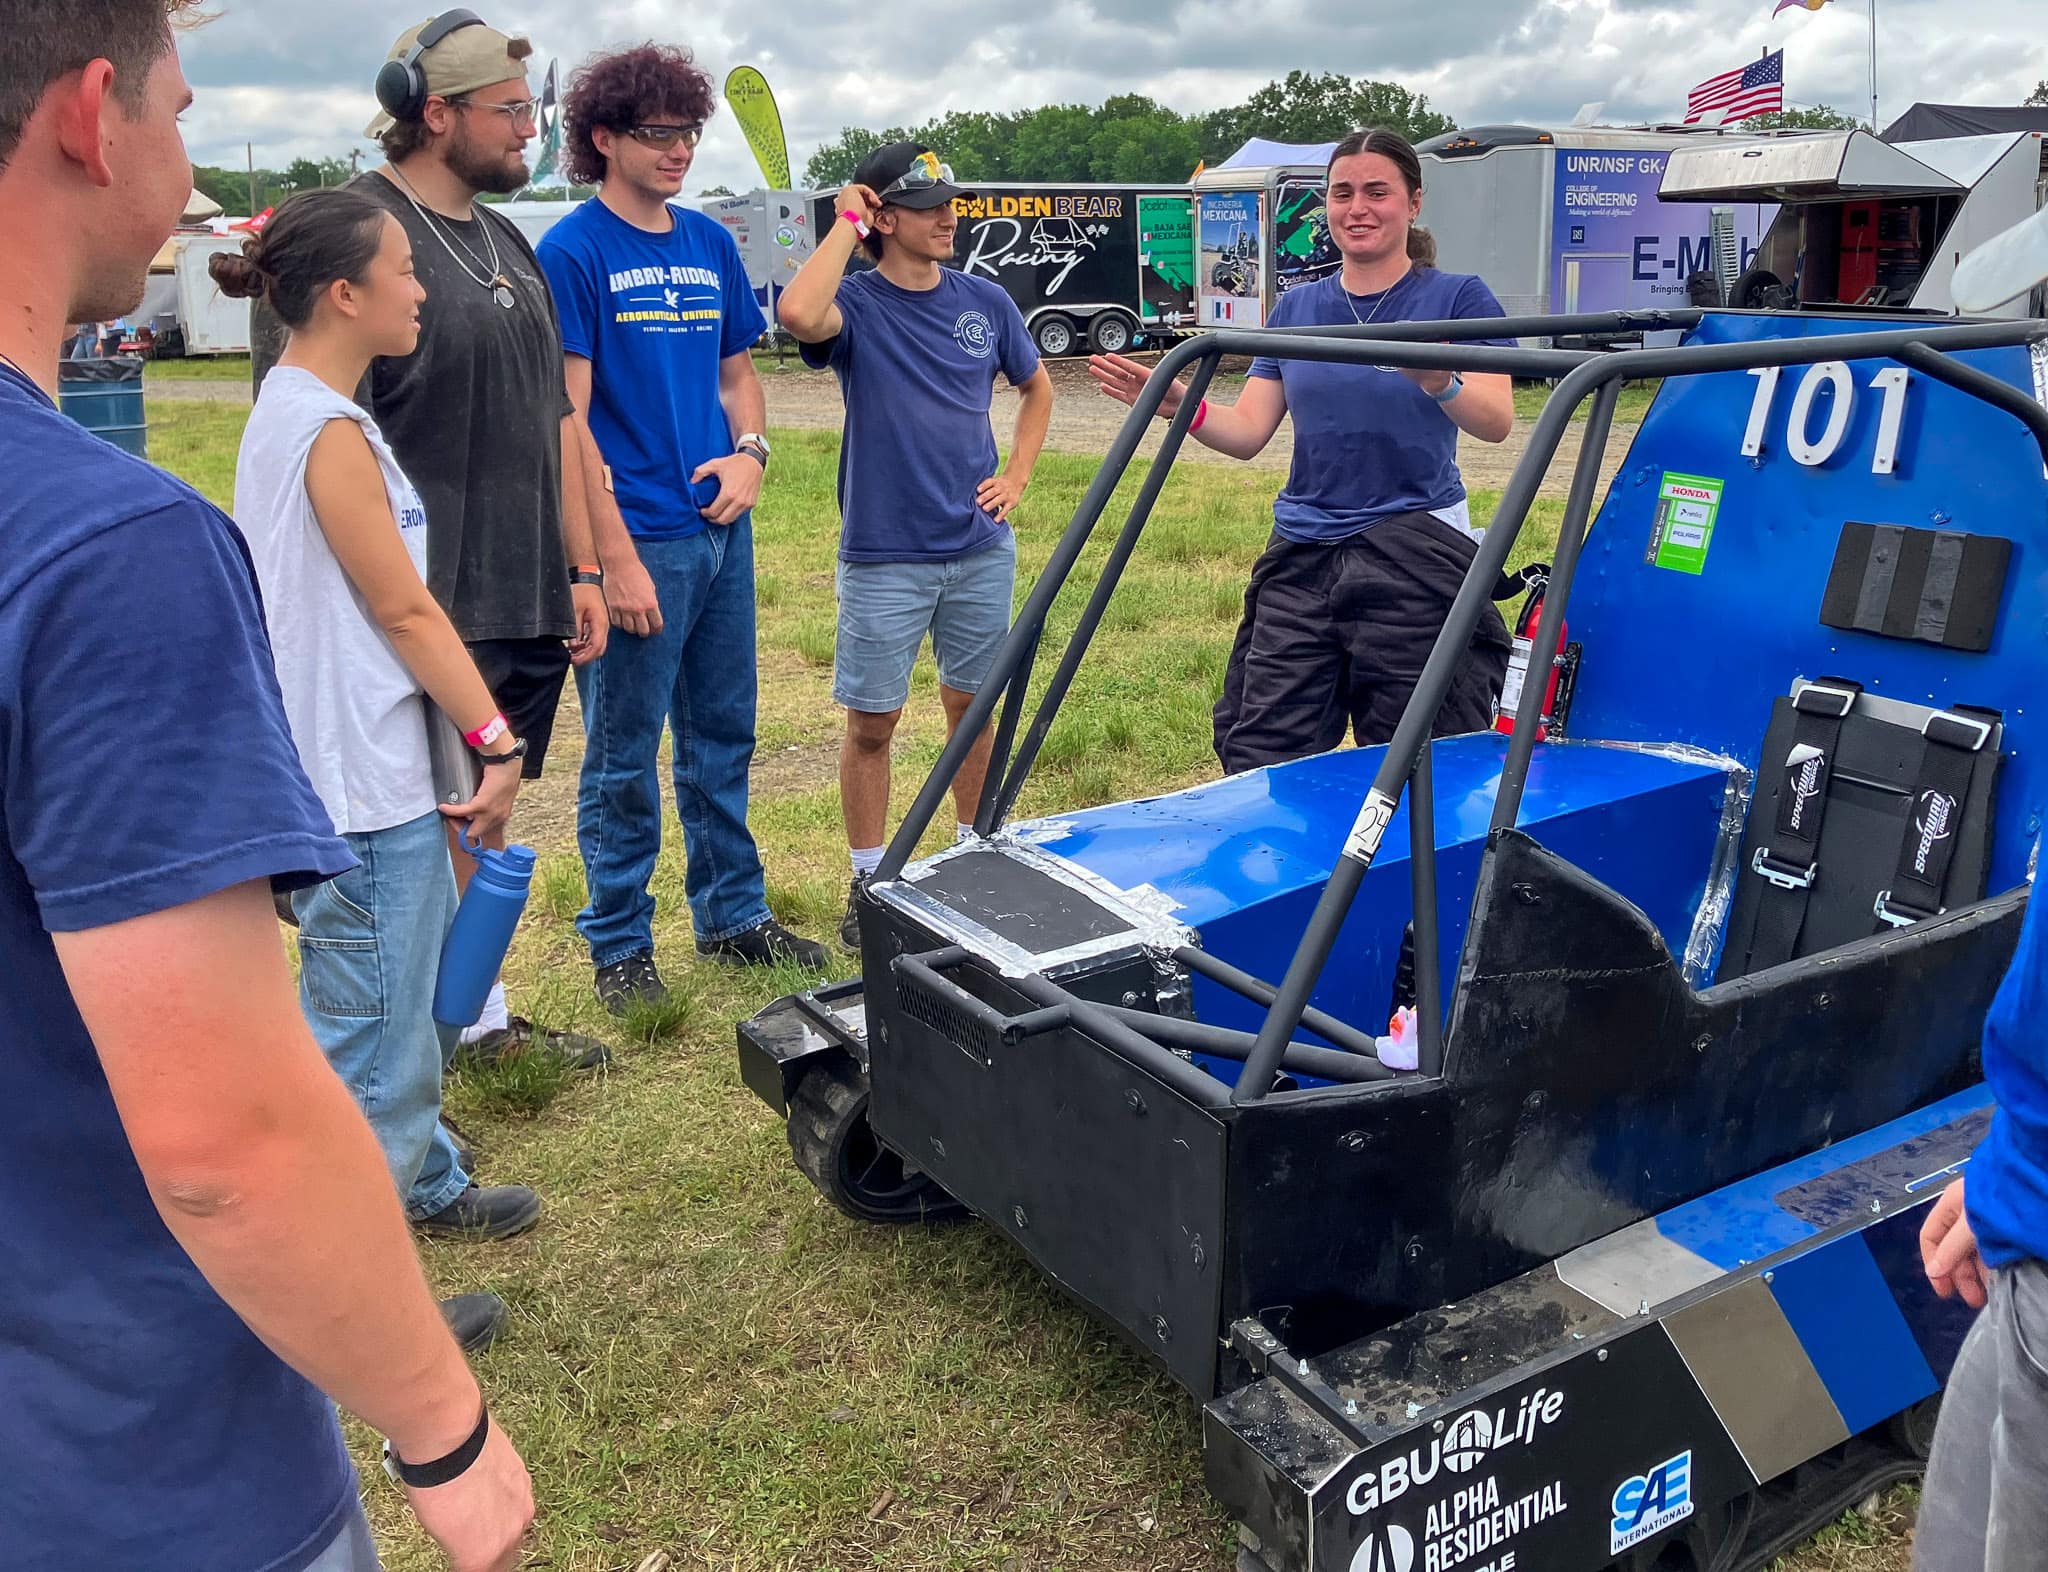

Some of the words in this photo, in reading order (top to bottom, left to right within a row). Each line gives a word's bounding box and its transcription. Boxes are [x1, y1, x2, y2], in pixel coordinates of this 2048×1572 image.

[1567, 155, 1635, 174] UNR/NSF
[1055, 196, 1122, 218] BEAR
[1203, 209, 1248, 221] MEXICANA
[1565, 192, 1638, 206] ENGINEERING
[963, 217, 1085, 296] Racing
[1650, 285, 1684, 296] Bringing
[1740, 360, 1909, 475] 101
[1671, 486, 1711, 500] HONDA
[1346, 1438, 1441, 1516] GBU
[1492, 1387, 1565, 1450] Life
[1424, 1475, 1500, 1542] ALPHA
[1613, 1454, 1689, 1533] SAE
[1424, 1480, 1568, 1572] RESIDENTIAL
